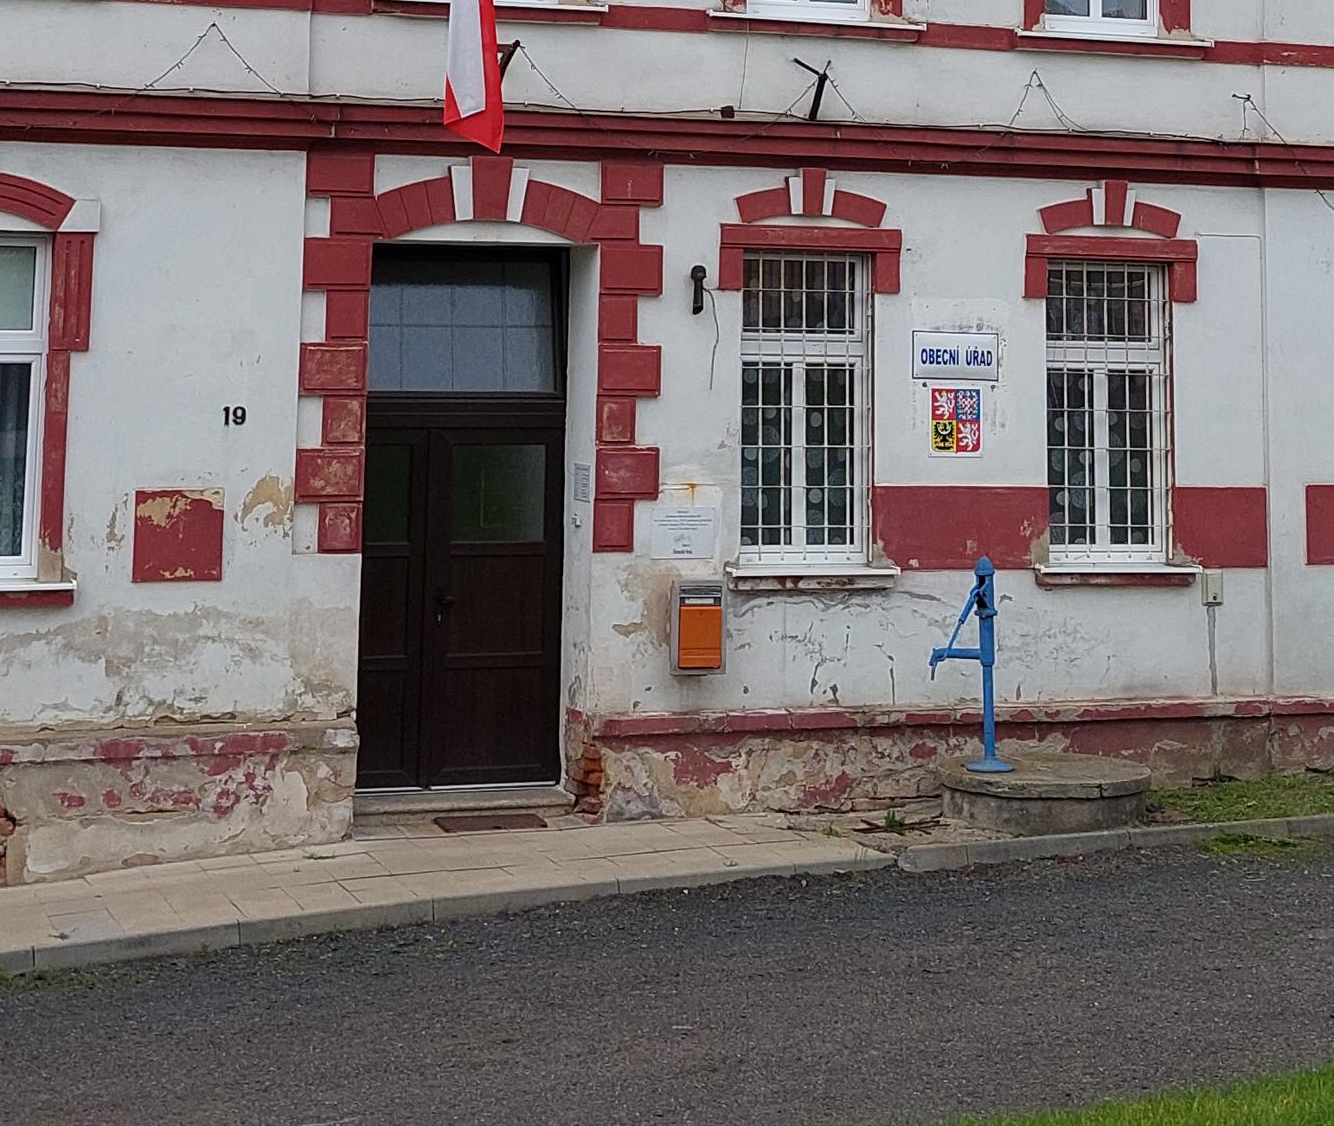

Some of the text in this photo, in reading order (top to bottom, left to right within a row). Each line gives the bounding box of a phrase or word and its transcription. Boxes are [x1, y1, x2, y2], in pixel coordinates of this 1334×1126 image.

[921, 345, 993, 367] OBECNÍ ÚŘAD
[223, 405, 246, 426] 19
